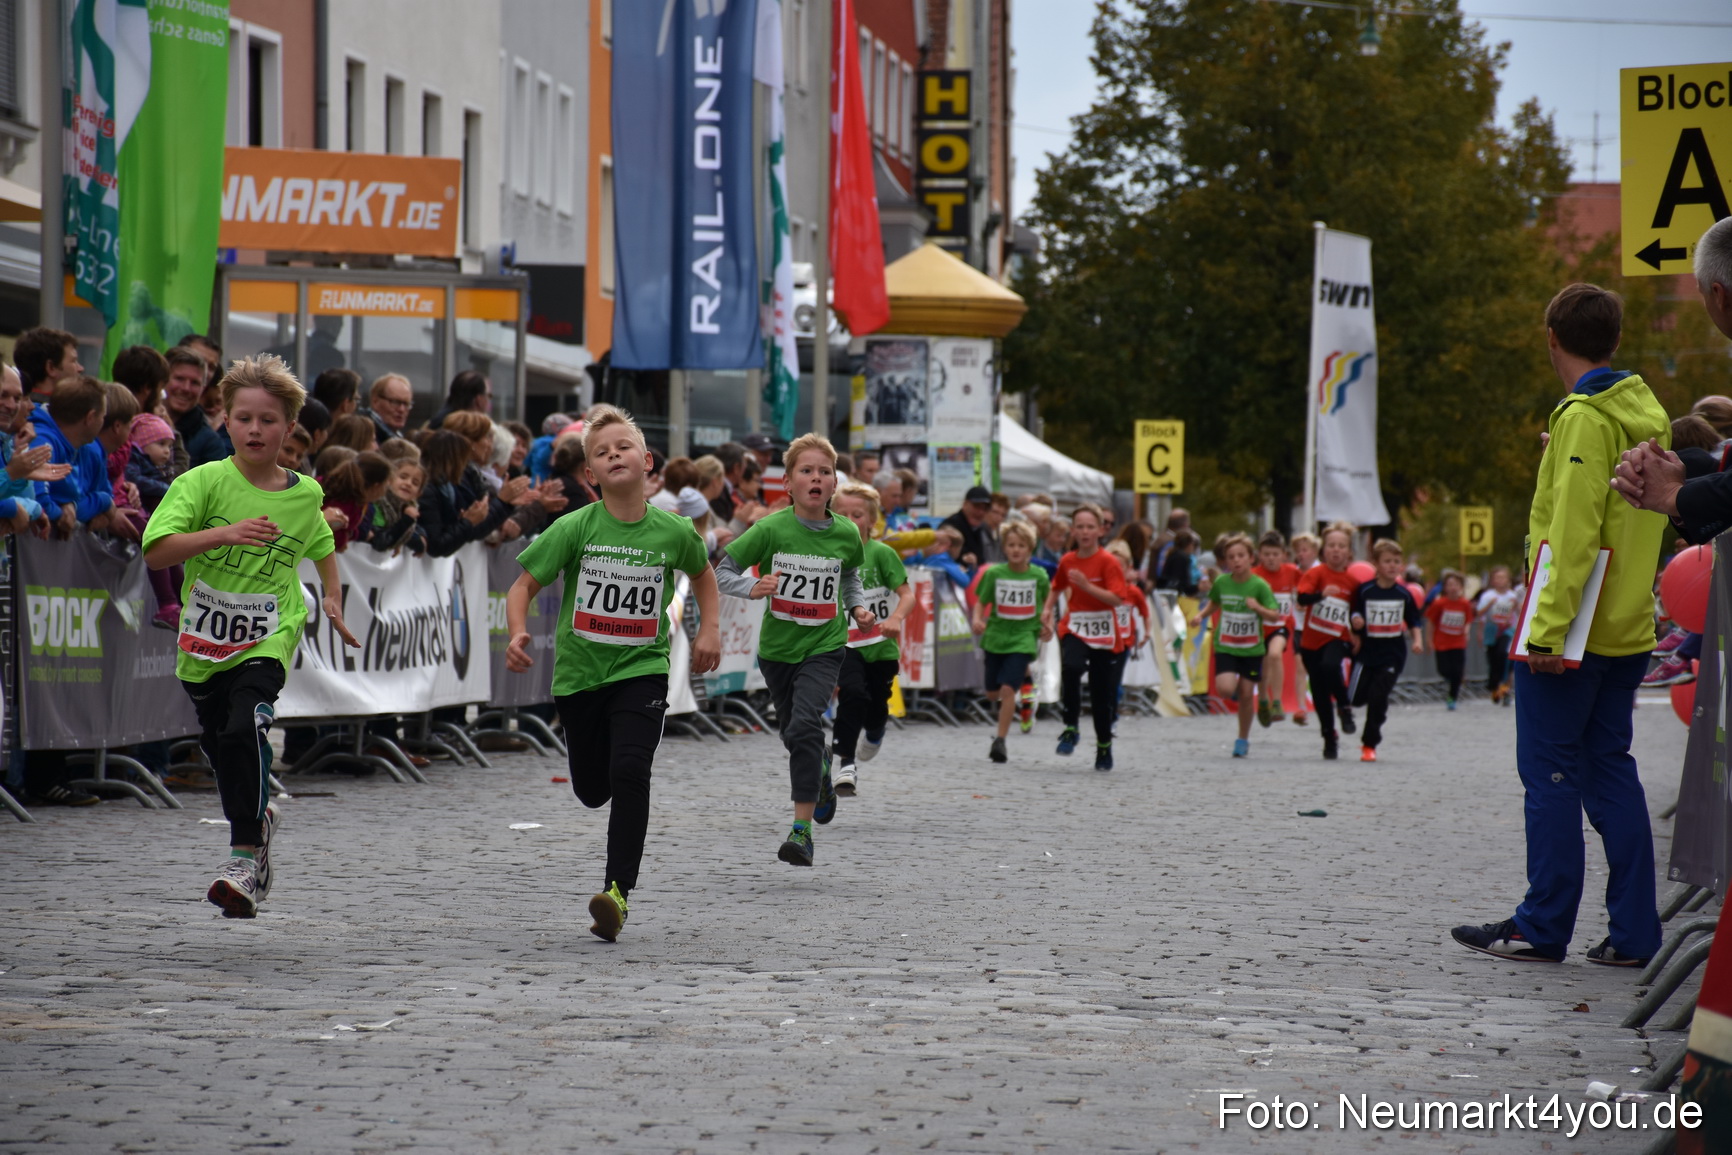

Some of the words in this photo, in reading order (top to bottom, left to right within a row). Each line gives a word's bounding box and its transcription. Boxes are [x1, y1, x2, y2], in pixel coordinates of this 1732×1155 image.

[921, 76, 970, 262] HOT
[1651, 127, 1732, 229] A
[1319, 278, 1371, 308] swn
[1142, 424, 1177, 438] Block
[1147, 443, 1170, 477] C
[1469, 522, 1485, 543] D
[584, 543, 643, 556] Neumarkter
[581, 567, 608, 579] PARTL
[610, 572, 652, 582] Neumarkt
[773, 560, 797, 571] PARTL
[798, 564, 832, 573] Neumarkt
[780, 573, 835, 600] 7216
[1000, 589, 1033, 604] 7418
[191, 587, 216, 605] PARTL
[218, 600, 261, 612] Neumarkt
[586, 580, 656, 615] 7049
[26, 594, 105, 648] BOCK
[790, 605, 818, 617] Jakob
[1317, 604, 1346, 623] 7164
[195, 603, 268, 643] 7065
[589, 618, 643, 635] Benjamin
[1073, 620, 1110, 636] 7139
[1225, 621, 1255, 635] 7091
